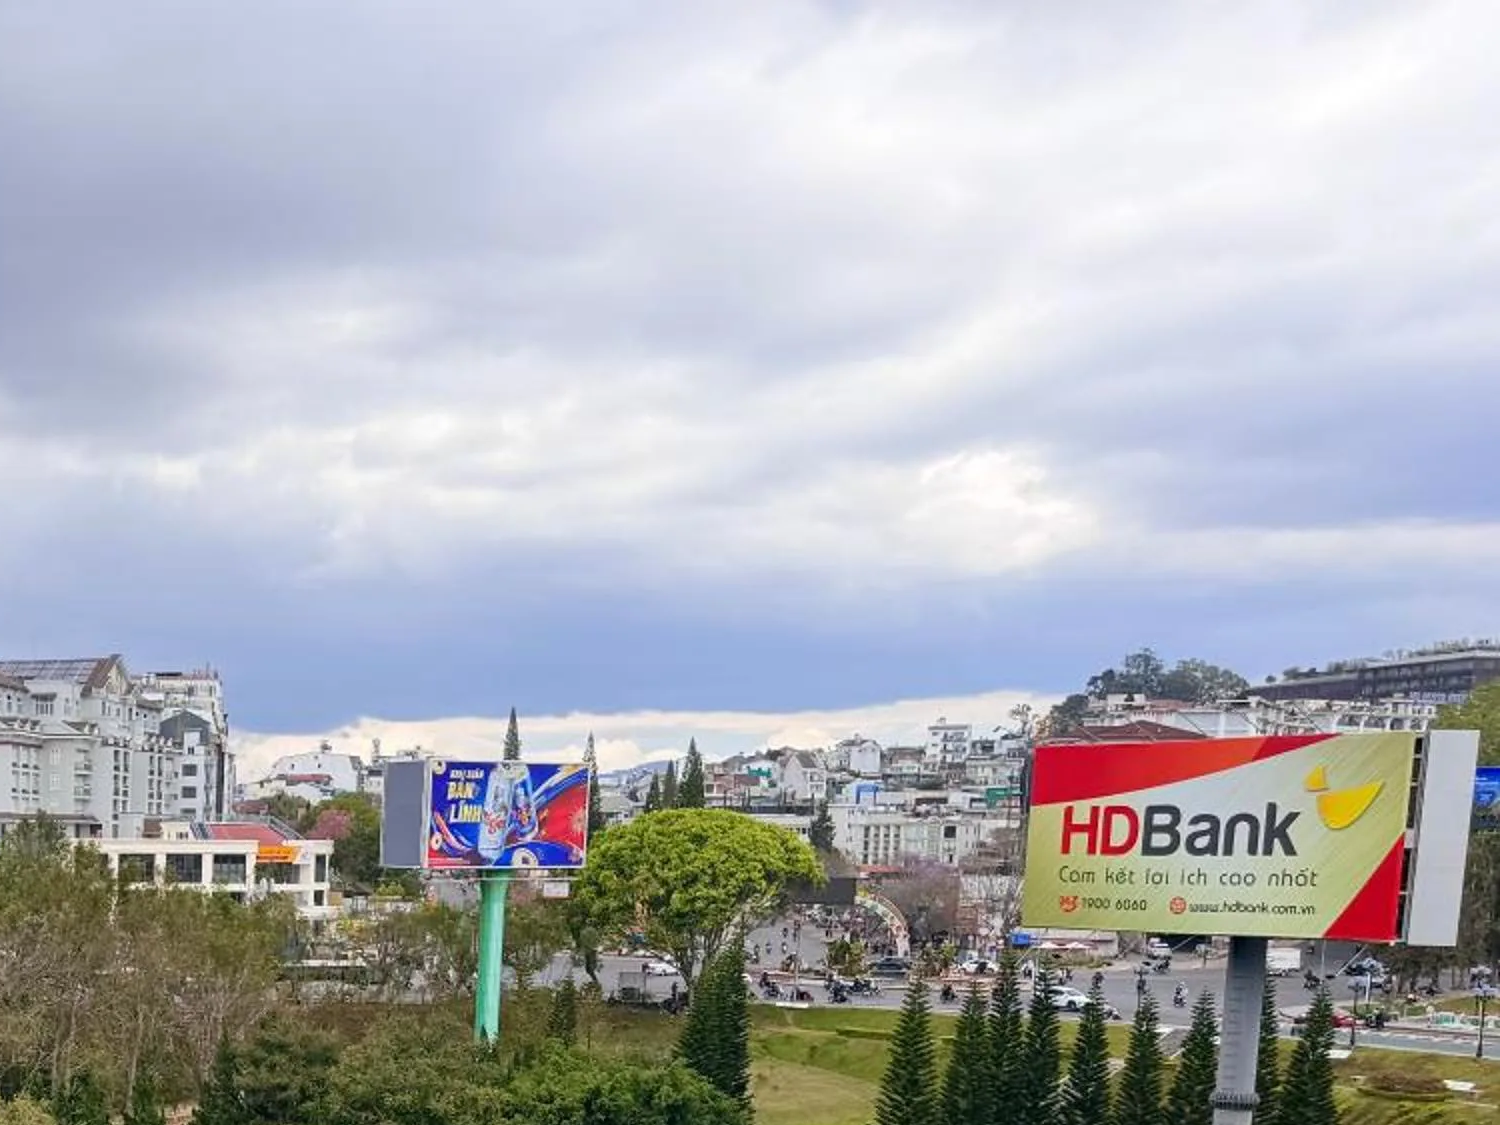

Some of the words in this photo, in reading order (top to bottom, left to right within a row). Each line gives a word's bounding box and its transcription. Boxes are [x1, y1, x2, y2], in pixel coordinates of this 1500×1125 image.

[1060, 802, 1301, 856] HDBank
[1058, 865, 1096, 884] Cam
[1219, 871, 1257, 886] cao
[1081, 897, 1111, 909] 1900
[1115, 899, 1148, 911] 6060
